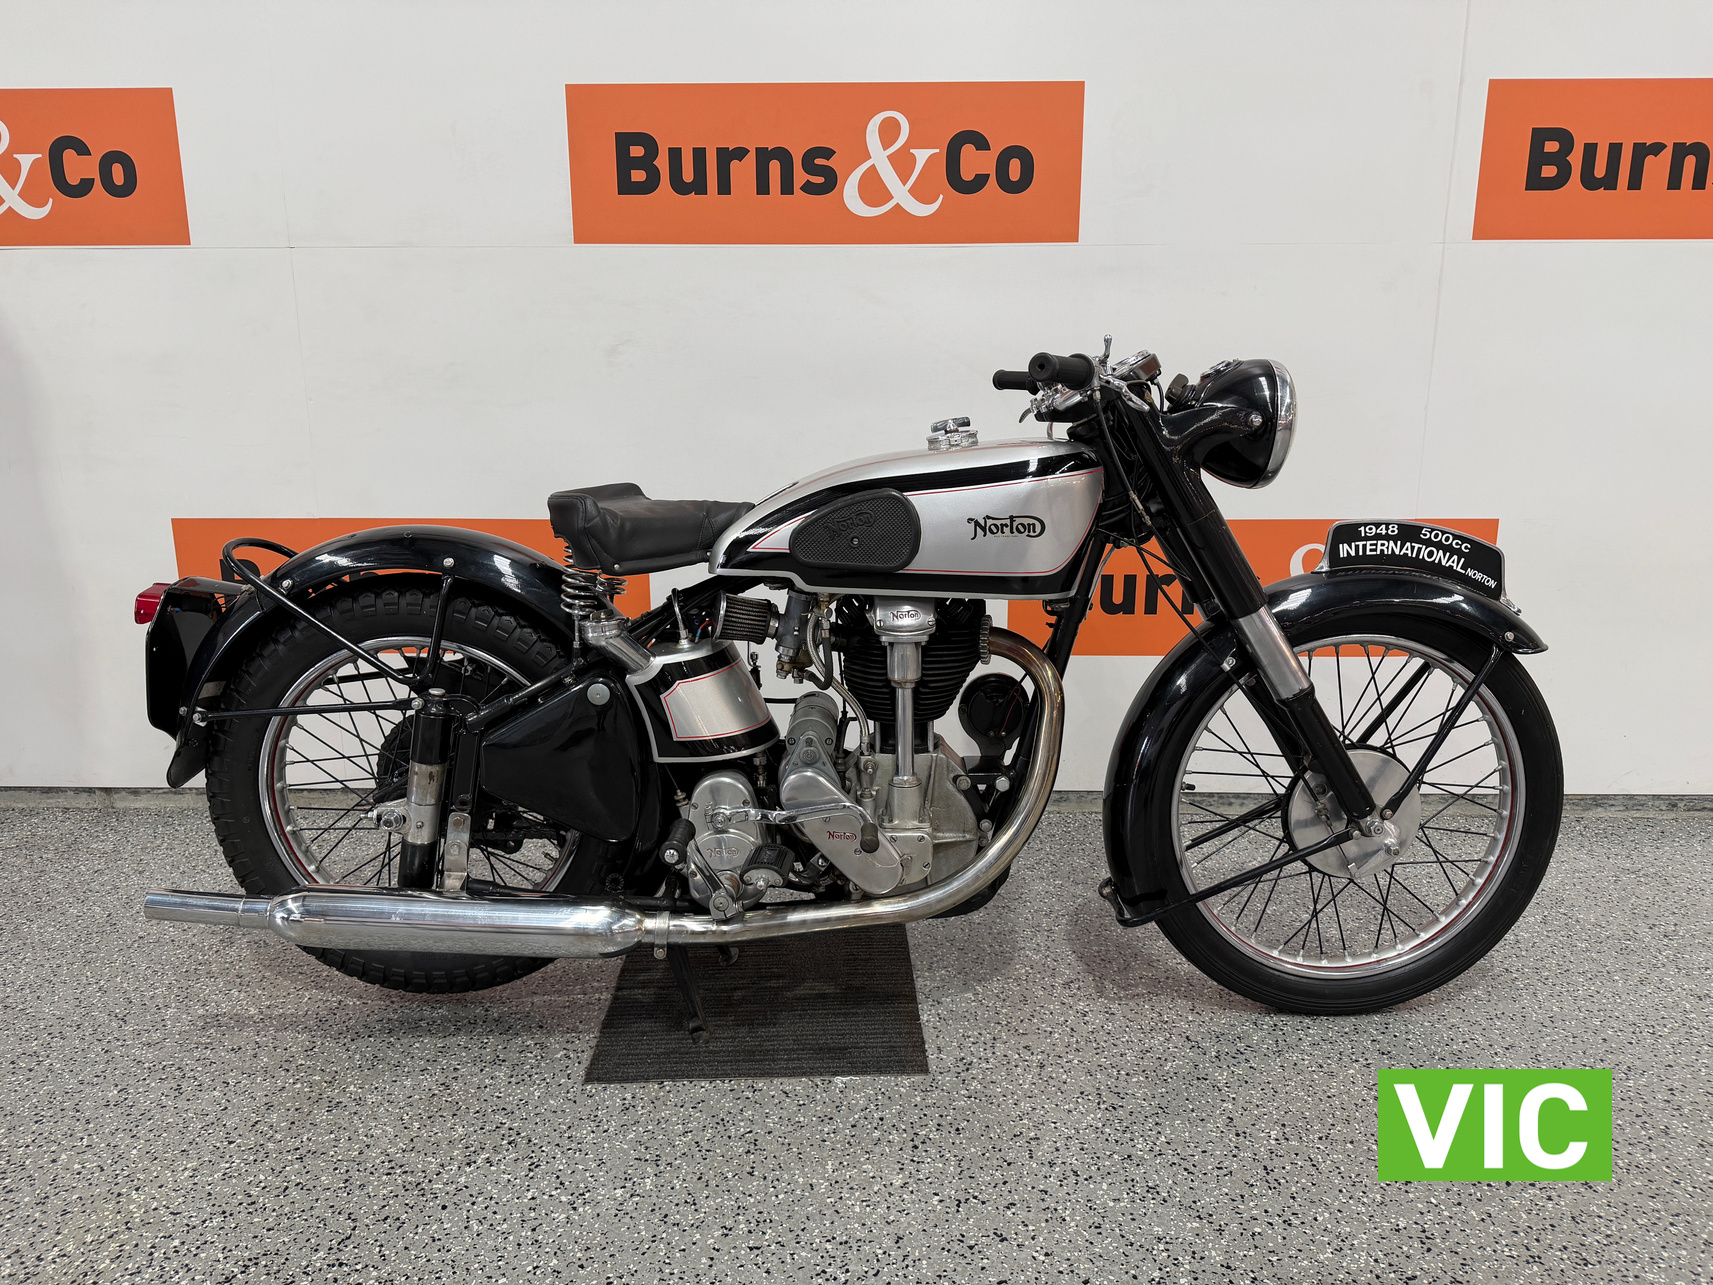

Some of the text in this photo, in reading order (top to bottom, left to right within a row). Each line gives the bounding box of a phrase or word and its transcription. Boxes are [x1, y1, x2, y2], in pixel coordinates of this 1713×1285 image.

[1525, 126, 1713, 191] Burn
[824, 509, 875, 539] Norton
[966, 514, 1046, 541] Norton
[1358, 523, 1471, 553] 1948 500cc
[1339, 540, 1466, 574] INTERNATIONAL
[1465, 567, 1498, 589] NORTON
[889, 609, 923, 621] Norton
[826, 830, 858, 842] Norton
